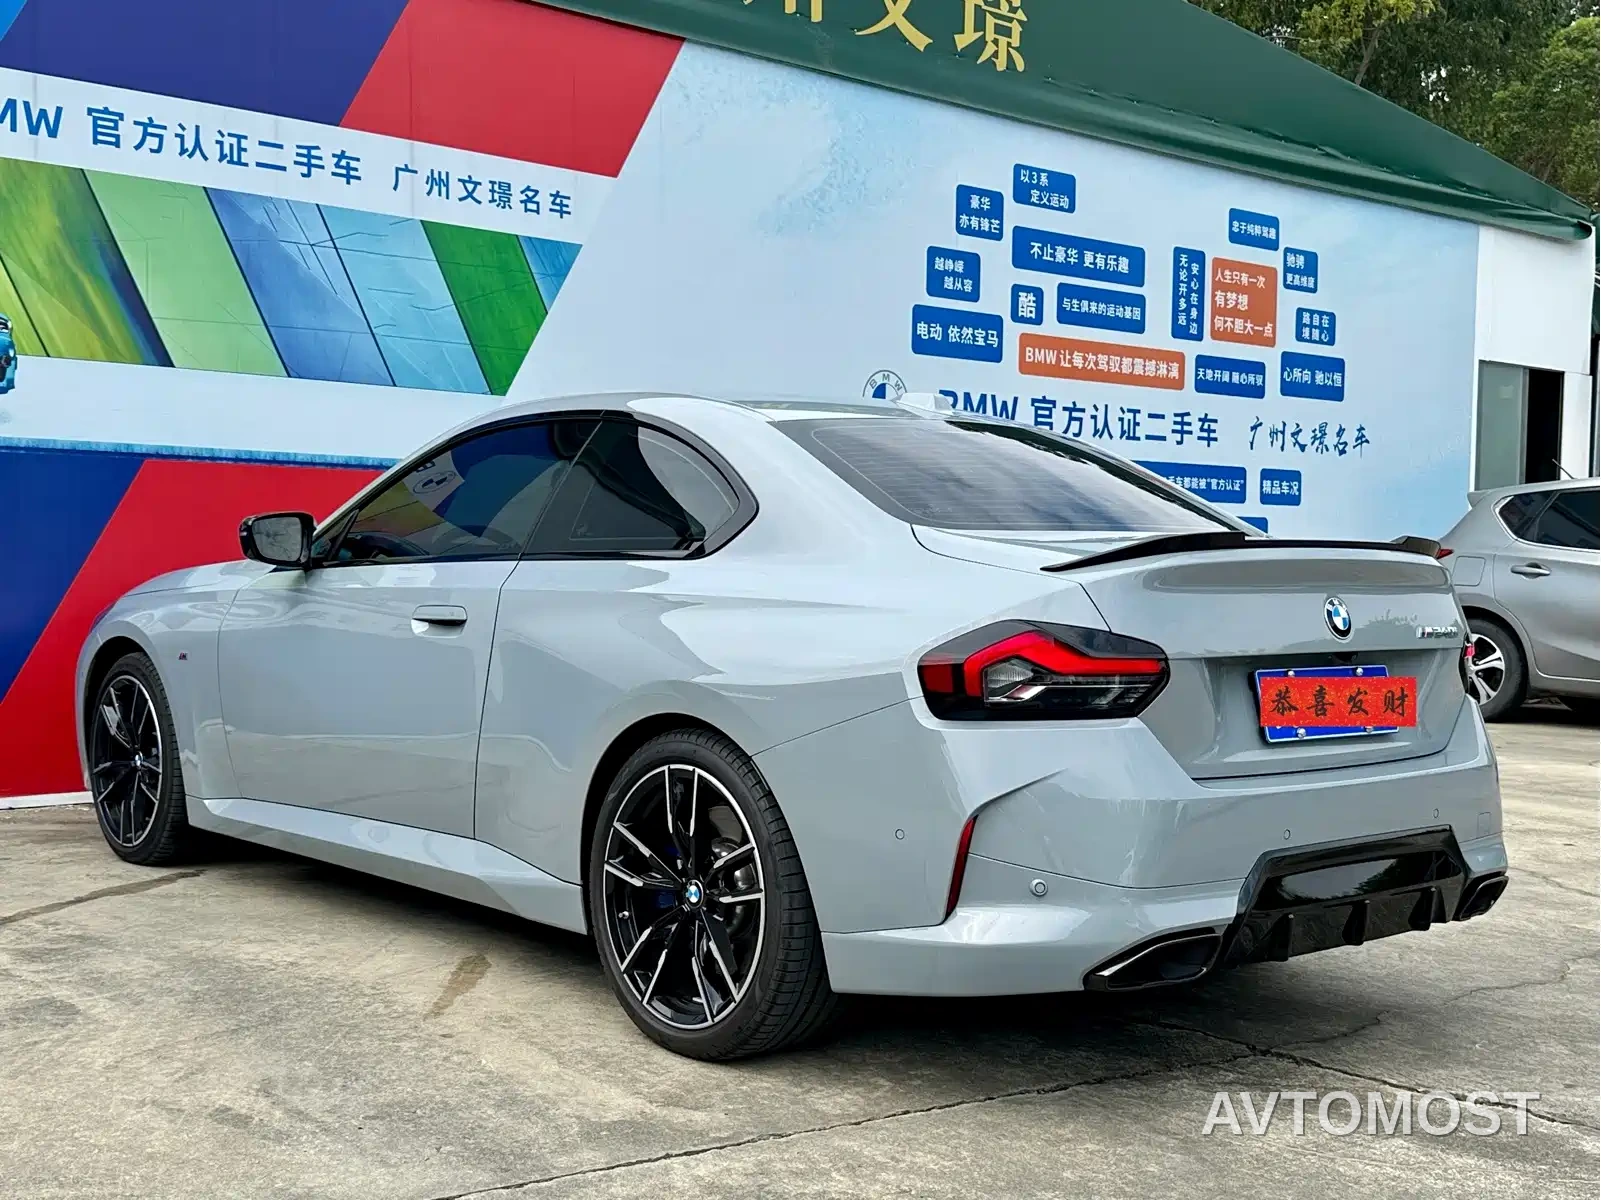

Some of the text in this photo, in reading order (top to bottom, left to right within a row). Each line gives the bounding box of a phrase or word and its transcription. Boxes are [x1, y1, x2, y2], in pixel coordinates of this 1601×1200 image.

[86, 106, 362, 185] 官方认证二手车
[1020, 168, 1049, 187] 以3系
[392, 163, 572, 219] 广州文璟名车
[1030, 188, 1070, 210] 定义运动
[969, 194, 991, 211] 豪华
[959, 213, 1001, 234] 亦有锋芒
[1231, 220, 1277, 240] 忠于纯粹驾趣
[934, 256, 964, 274] 越峥嵘
[1030, 241, 1130, 274] 不止豪华 更有乐趣
[943, 275, 973, 293] 越从容
[1214, 268, 1266, 289] 人生只有一次
[1177, 254, 1189, 326] 无论开多远
[1189, 262, 1200, 335] 安心在身边
[1214, 290, 1249, 311] 有梦想
[1018, 291, 1037, 319] 酷
[1062, 297, 1142, 321] 与生俱来的运动基因
[1213, 315, 1274, 338] 何不胆大一点
[1302, 311, 1330, 328] 路自在
[916, 321, 999, 348] 电动 依然宝马
[1025, 347, 1180, 380] BMW 让每次驾驭都震撼淋漓
[1197, 367, 1264, 387] 天地开阔 随心所驭
[1283, 366, 1312, 384] 心所向
[1030, 396, 1219, 448] 官方认证二手车
[1248, 416, 1371, 460] 广州文璟名车
[1262, 480, 1300, 496] 精品车况
[1269, 684, 1409, 717] 恭喜发财
